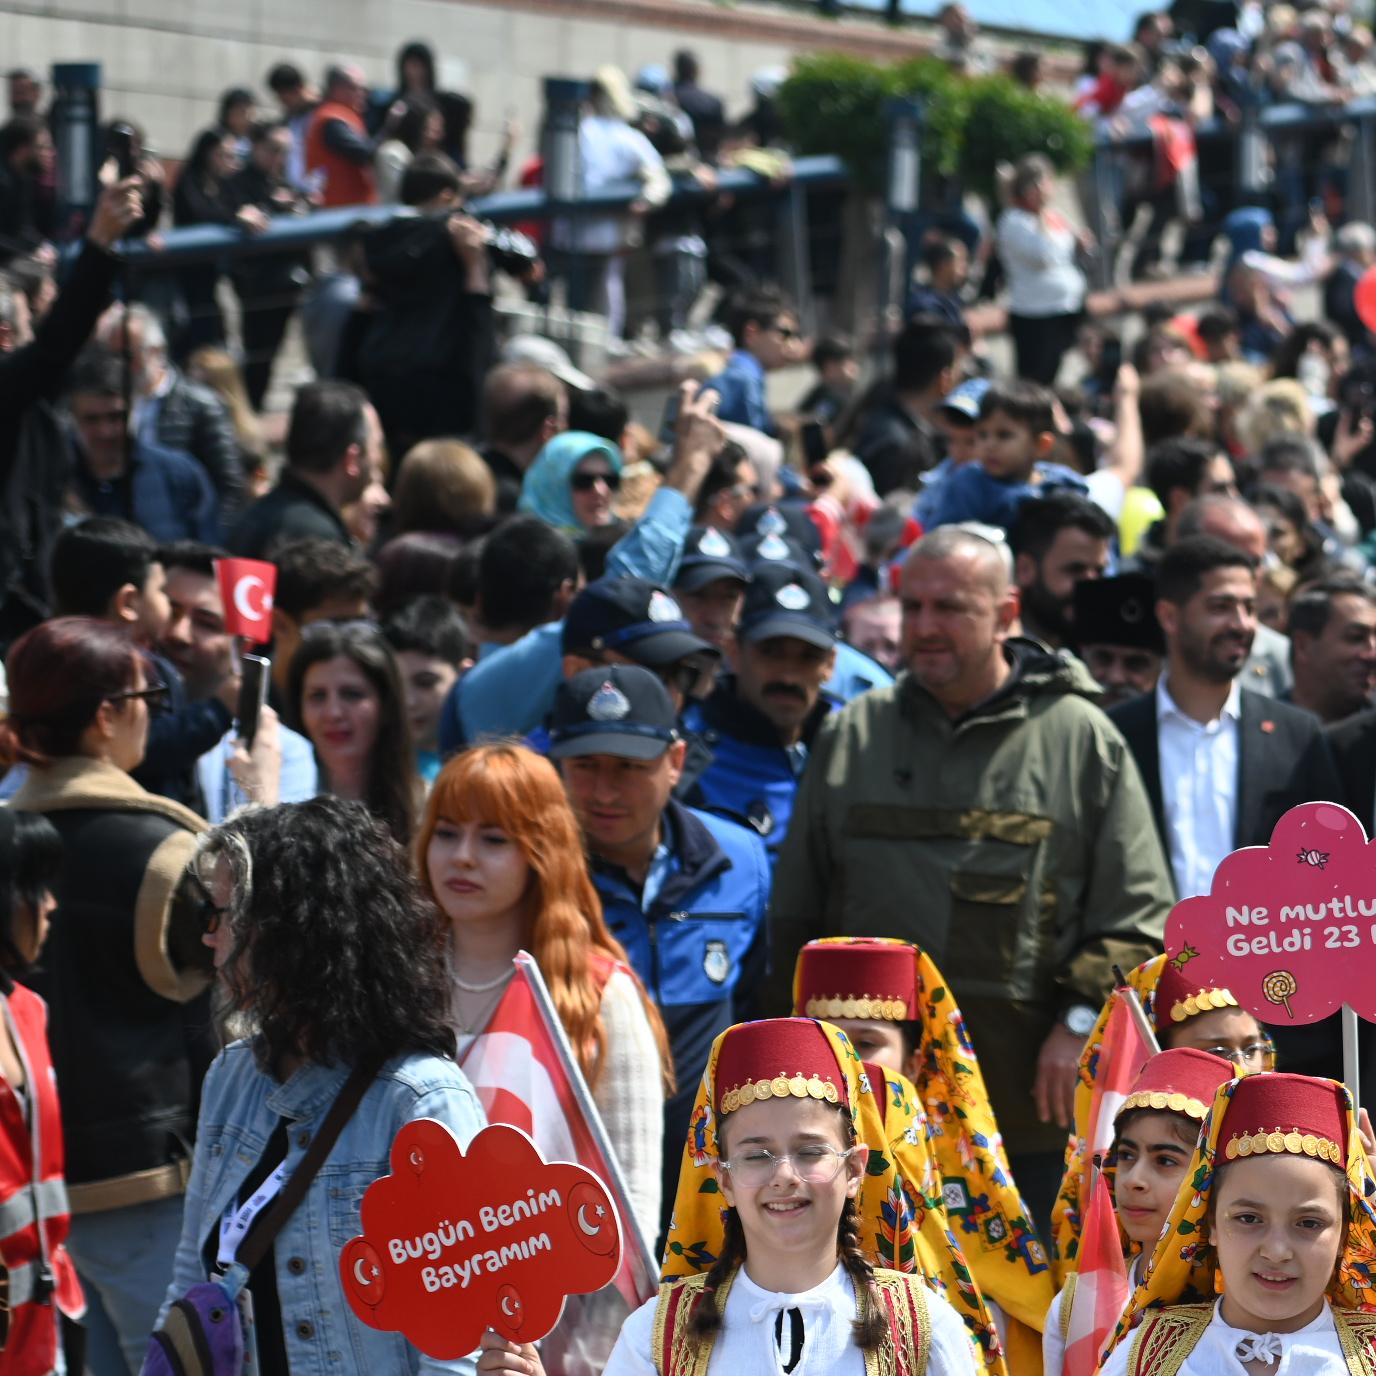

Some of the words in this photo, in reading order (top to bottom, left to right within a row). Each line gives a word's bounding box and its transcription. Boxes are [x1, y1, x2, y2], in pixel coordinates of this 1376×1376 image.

[1225, 905, 1269, 927] Ne
[1226, 927, 1312, 957] Geldi
[1324, 926, 1360, 949] 23
[387, 1219, 475, 1265] Bugün
[479, 1188, 562, 1233] Benim
[421, 1231, 552, 1293] Bayramım
